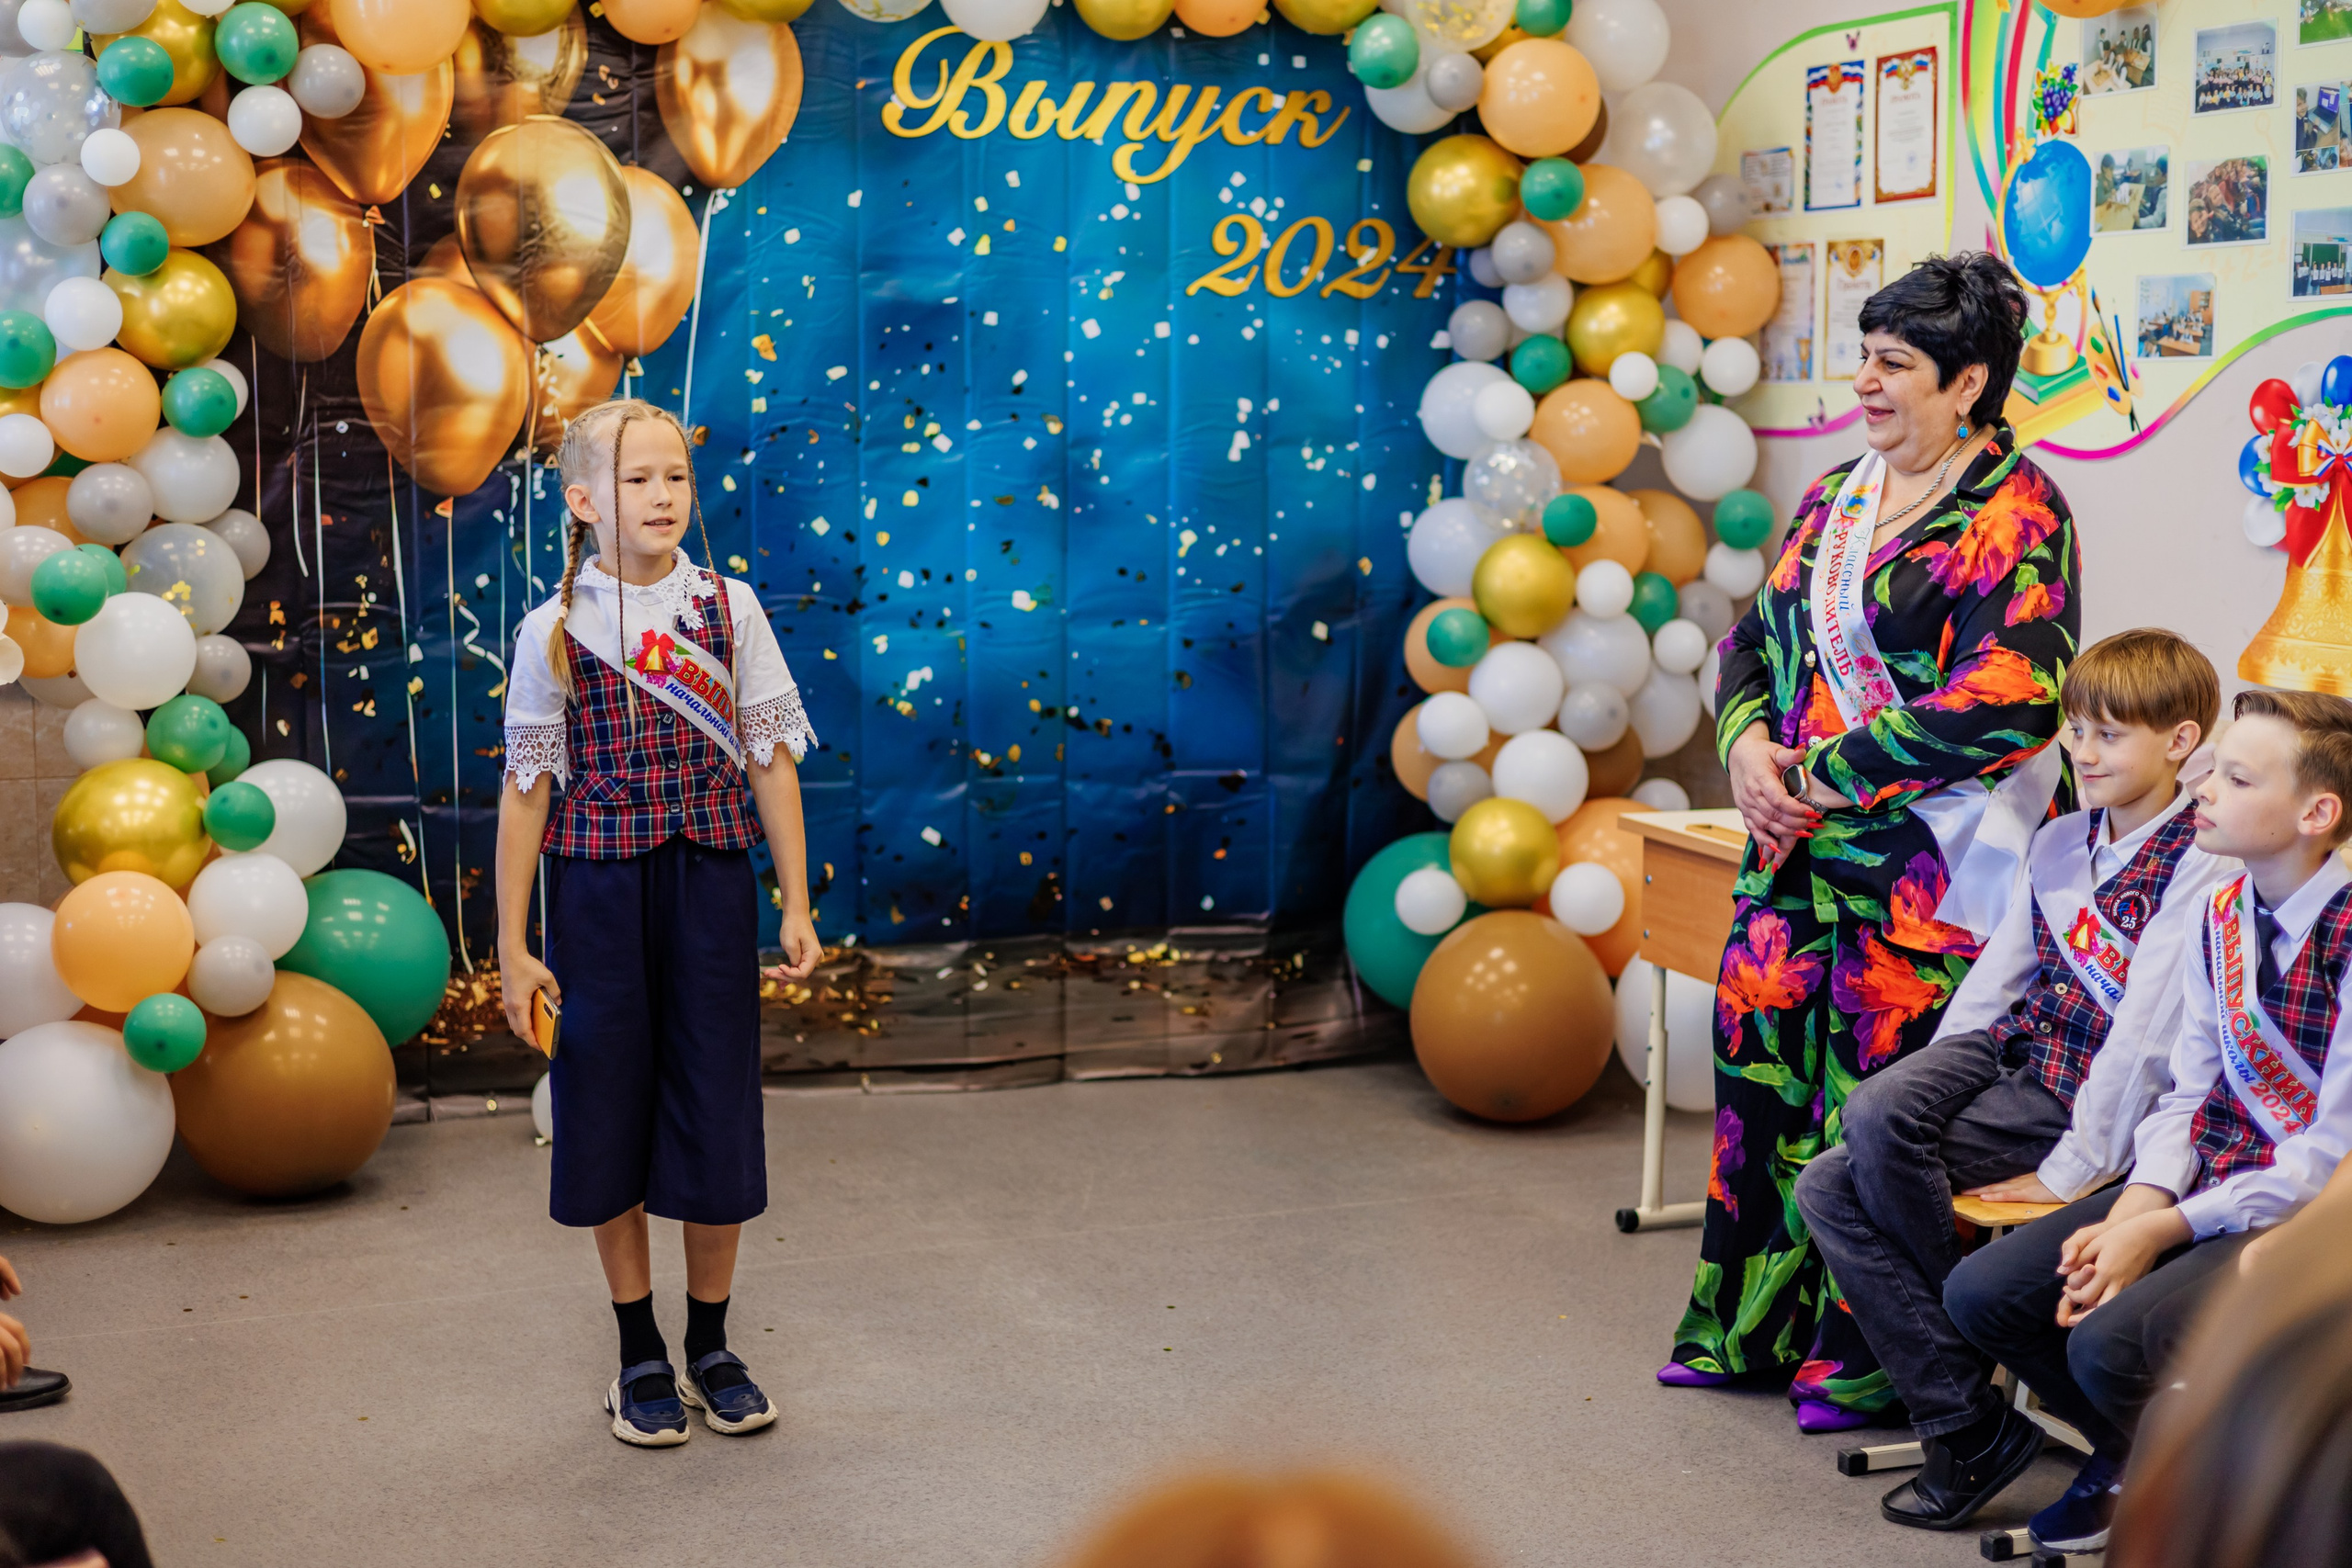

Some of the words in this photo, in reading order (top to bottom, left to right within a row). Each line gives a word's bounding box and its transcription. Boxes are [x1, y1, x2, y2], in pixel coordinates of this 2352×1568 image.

[881, 25, 1351, 184] Выпуск
[1186, 213, 1457, 299] 2024
[1838, 527, 1871, 610] Классный
[665, 682, 731, 739] начальной
[2120, 915, 2137, 929] 25
[2223, 912, 2318, 1124] ВЫПУСКНИК
[2222, 1024, 2256, 1084] школы
[2249, 1081, 2304, 1134] 2024
